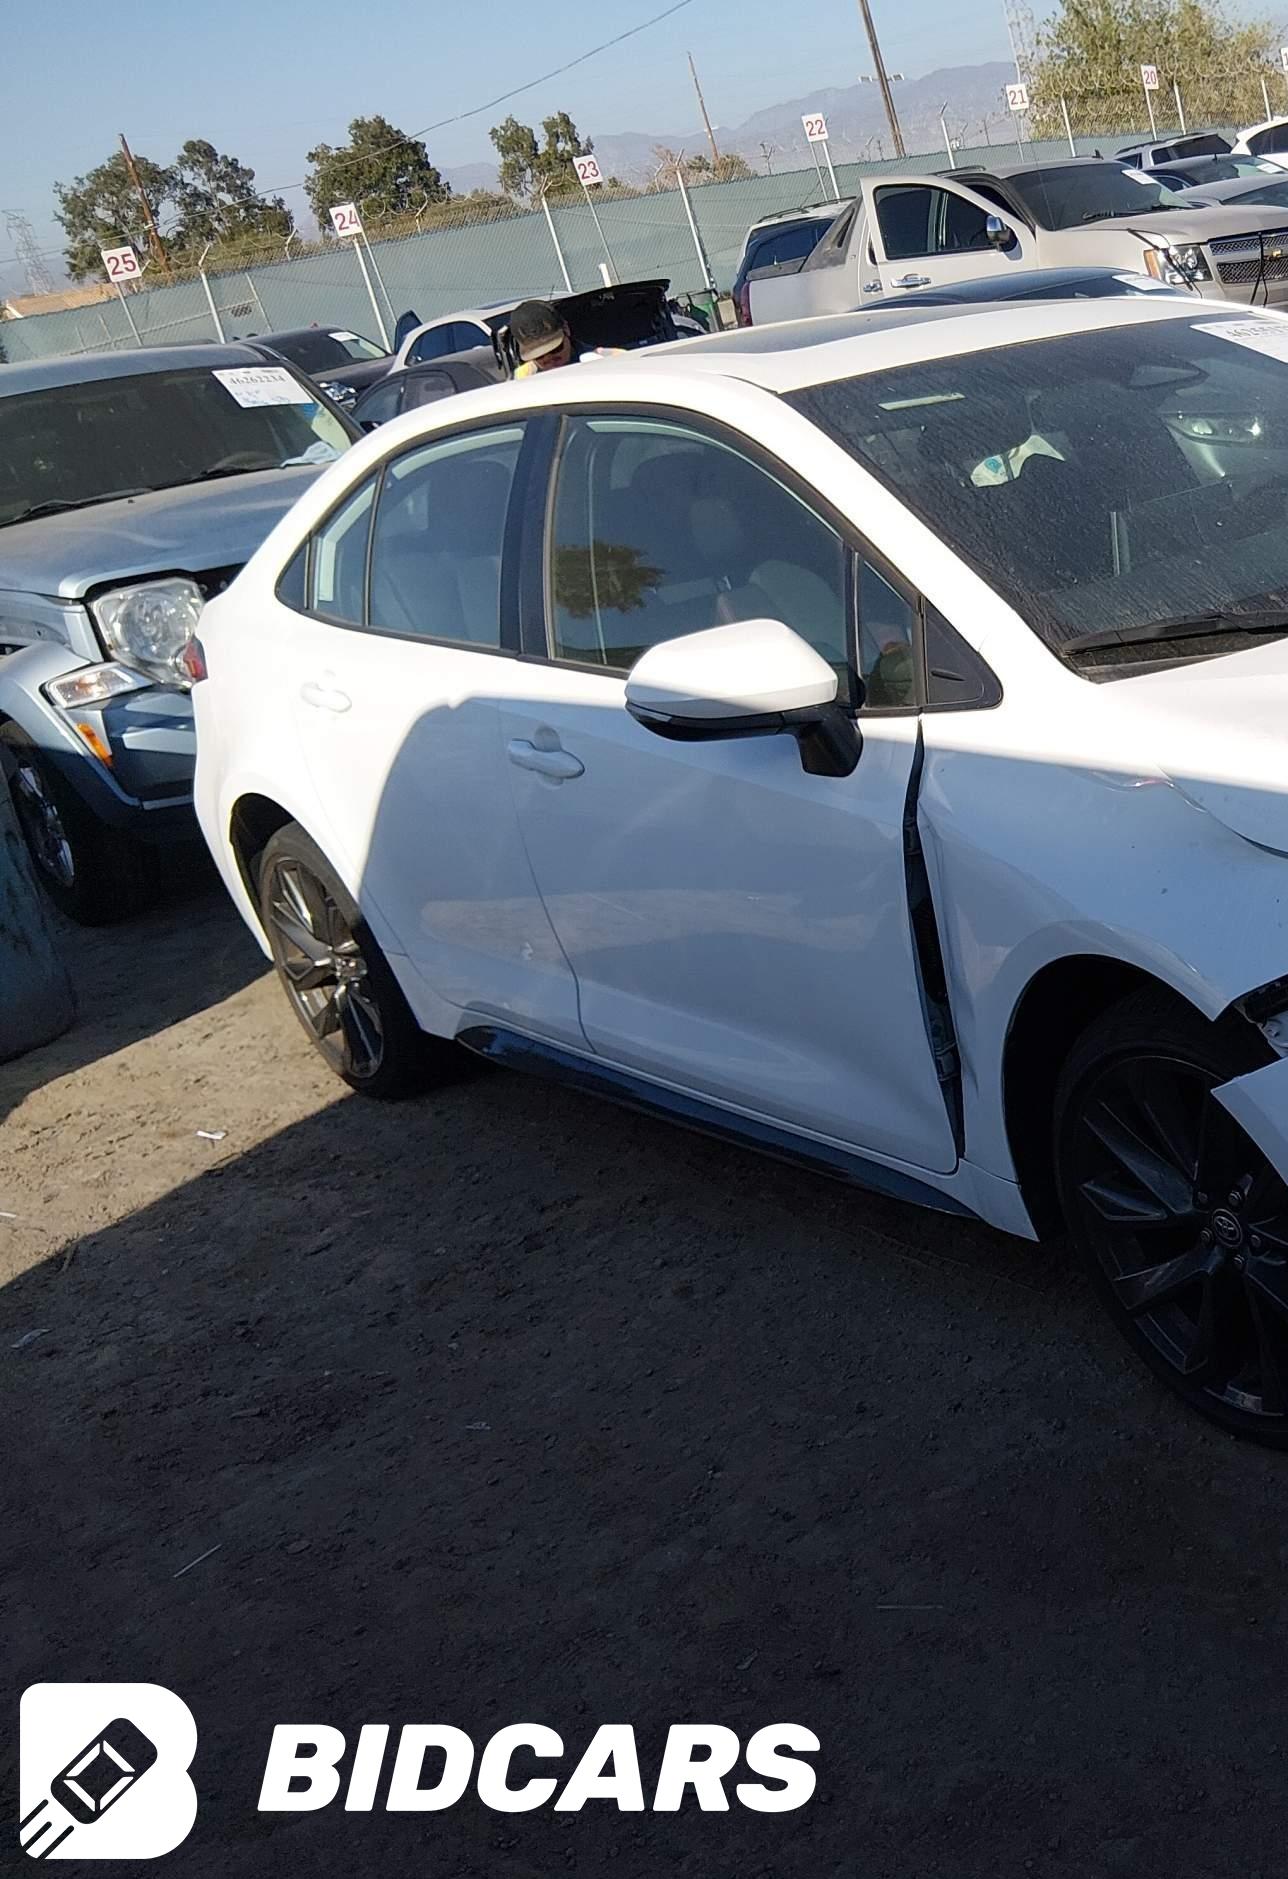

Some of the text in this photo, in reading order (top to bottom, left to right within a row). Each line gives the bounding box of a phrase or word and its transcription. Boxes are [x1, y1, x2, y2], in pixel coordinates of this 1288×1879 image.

[1143, 69, 1157, 85] 20
[1009, 89, 1026, 105] 21
[805, 119, 826, 136] 22
[577, 160, 599, 180] 23
[334, 210, 360, 231] 24
[106, 253, 137, 277] 25
